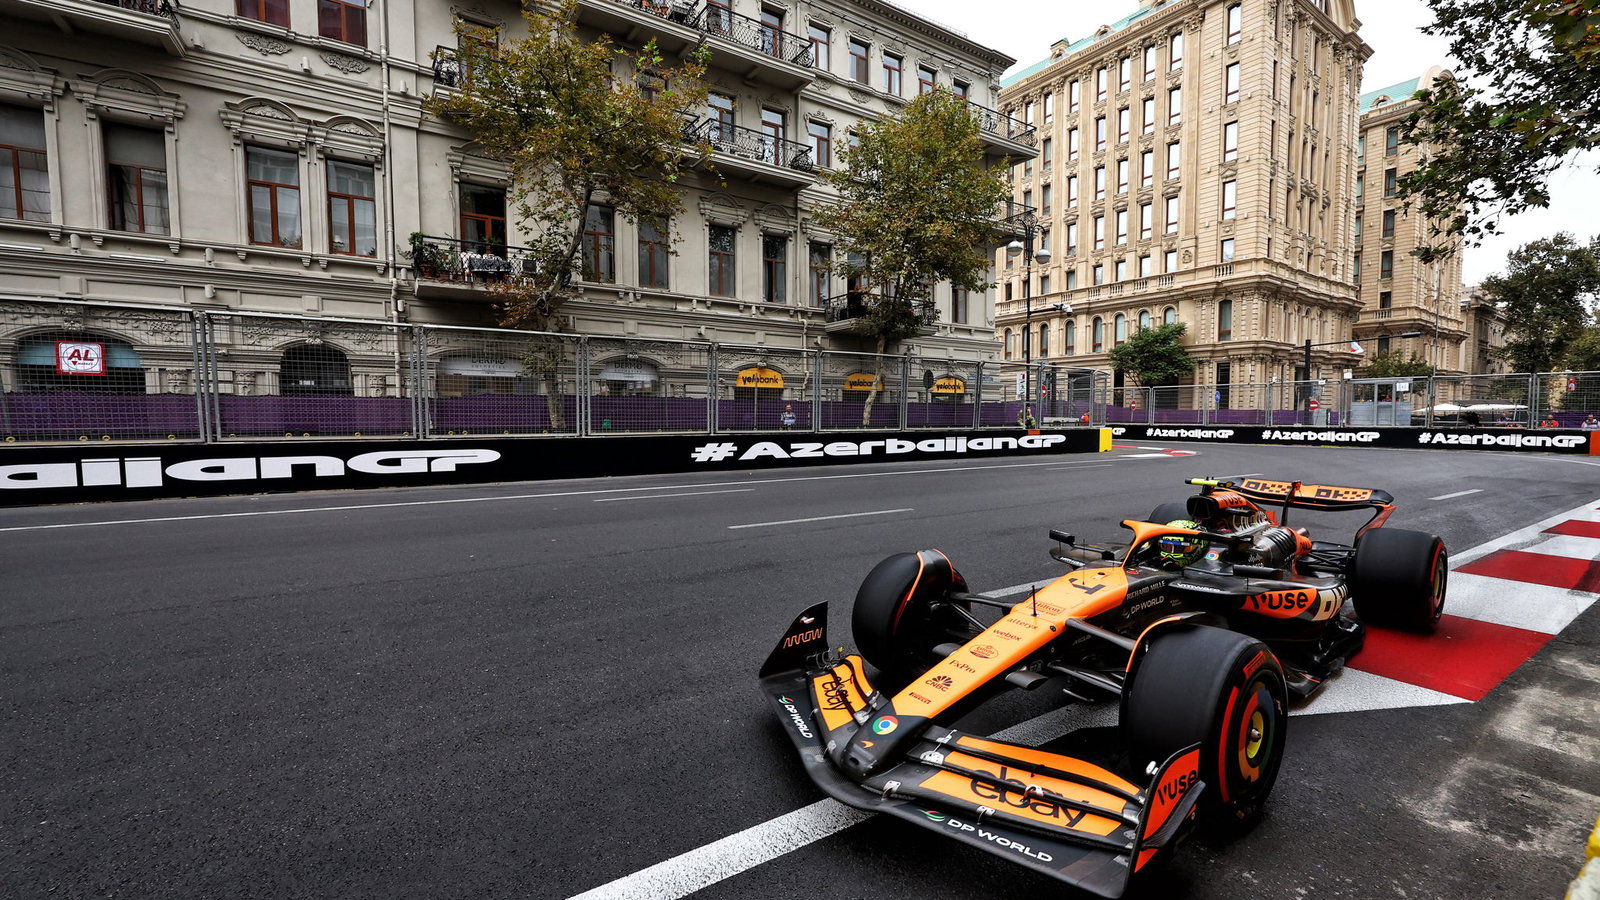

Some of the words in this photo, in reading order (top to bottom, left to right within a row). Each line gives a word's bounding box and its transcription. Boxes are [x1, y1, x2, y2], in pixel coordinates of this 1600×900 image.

[68, 349, 94, 361] AL
[742, 374, 779, 385] yelobank
[849, 379, 874, 389] yeloba
[1146, 428, 1235, 439] #AzerbaijanGP
[1262, 430, 1380, 442] #AzerbaijanGP
[1418, 432, 1587, 448] #AzerbaijanGP
[691, 434, 1066, 462] #AzerbaijanGP
[1127, 586, 1150, 600] RICHARD
[1150, 580, 1166, 592] MILLE
[1130, 604, 1141, 615] DP
[1141, 596, 1165, 610] WORLD
[1007, 618, 1038, 630] alteryx
[993, 629, 1022, 641] webex
[949, 660, 976, 674] FxPro
[925, 680, 949, 692] CNBC
[785, 704, 797, 716] DP
[790, 712, 813, 739] WORLD
[970, 766, 1090, 827] ebay
[947, 819, 975, 832] DP
[977, 829, 1053, 862] WORLD
